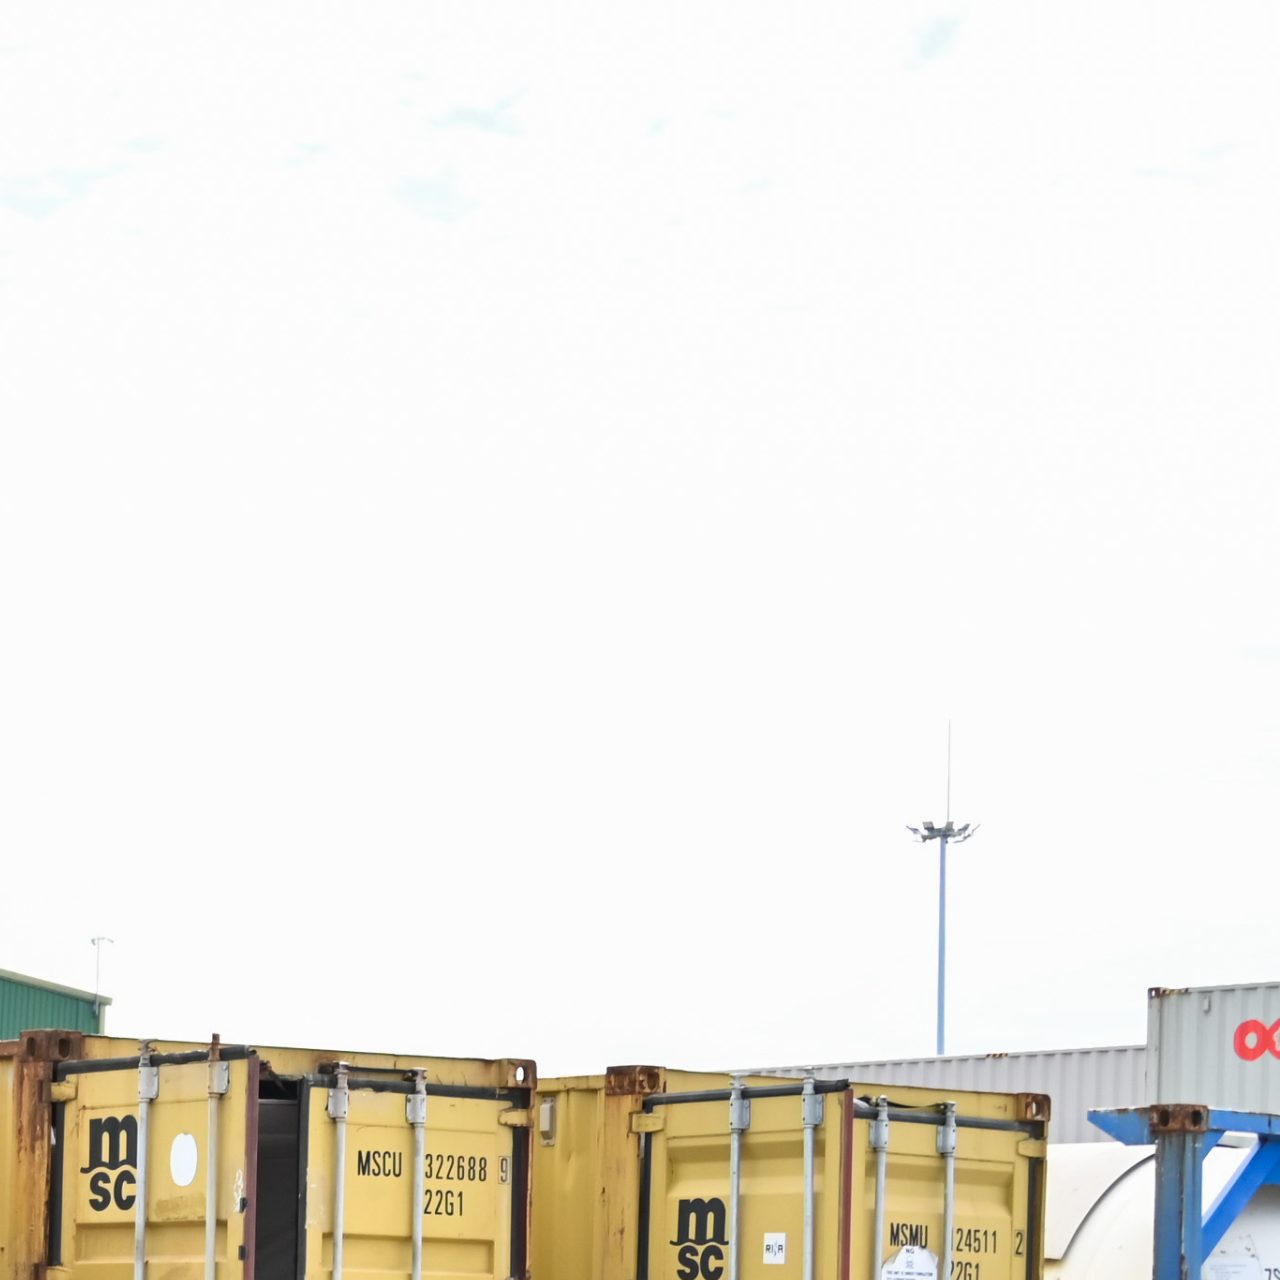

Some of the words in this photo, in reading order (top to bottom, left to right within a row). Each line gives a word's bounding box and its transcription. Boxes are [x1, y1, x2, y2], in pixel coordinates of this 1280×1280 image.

[357, 1150, 403, 1178] MSCU
[424, 1153, 488, 1182] 322688
[500, 1158, 509, 1183] 9
[423, 1188, 464, 1217] 22G1
[889, 1222, 928, 1249] MSMU
[1015, 1232, 1023, 1256] 2
